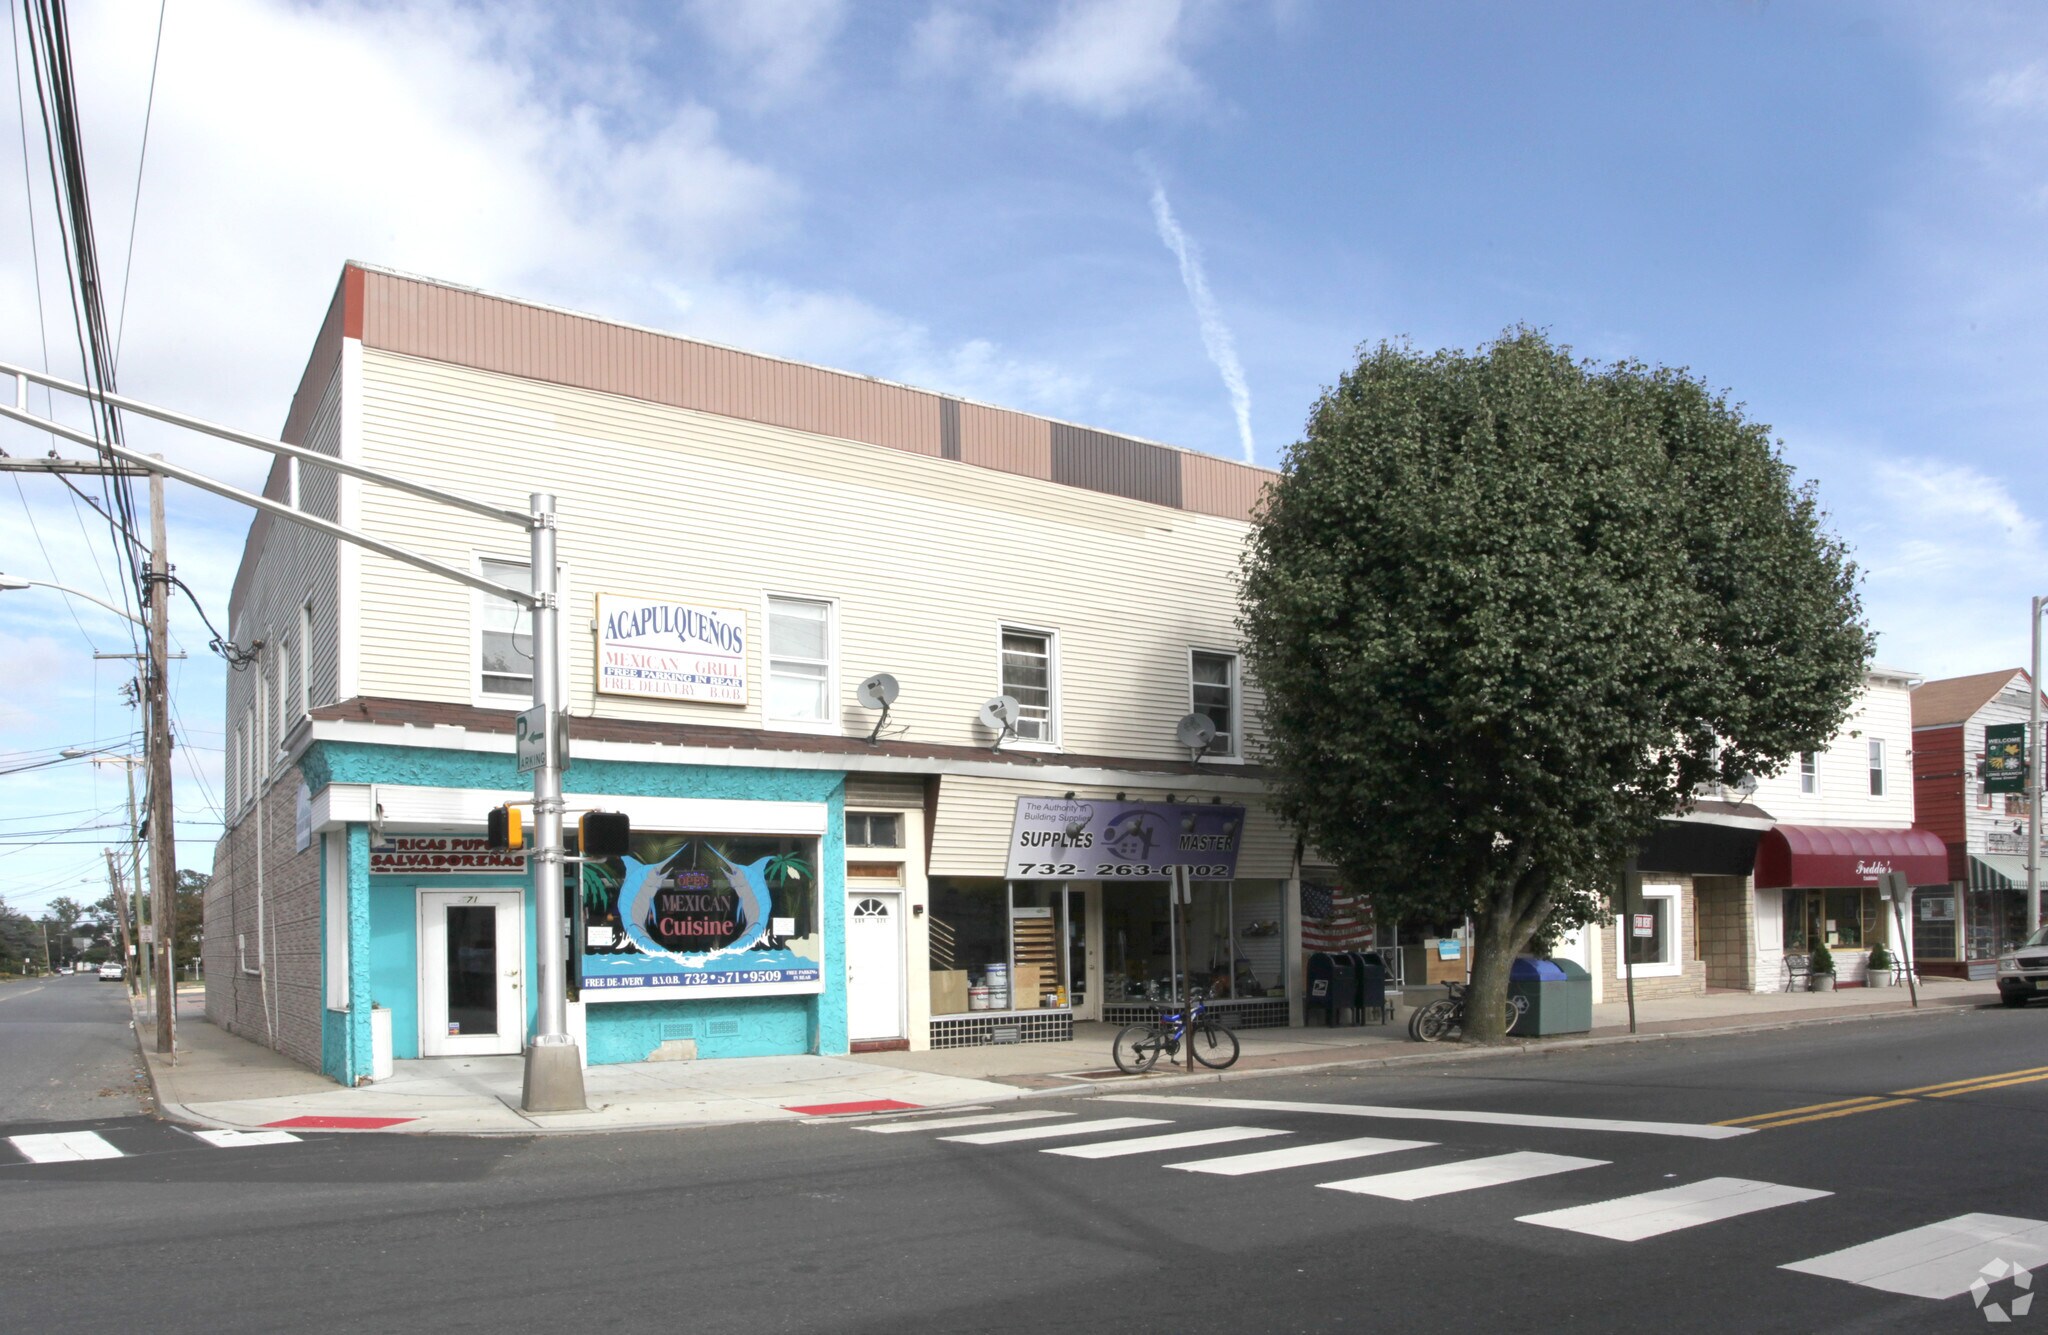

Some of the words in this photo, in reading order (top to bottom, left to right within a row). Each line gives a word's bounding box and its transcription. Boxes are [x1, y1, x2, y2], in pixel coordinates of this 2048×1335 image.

[605, 606, 743, 654] ACAPULQUEÑOS
[606, 651, 679, 671] MEXICAN
[695, 660, 741, 677] GRILL
[607, 667, 638, 677] FREE
[641, 670, 692, 683] PARKING
[695, 675, 707, 684] IN
[710, 676, 741, 687] REAR
[605, 678, 636, 691] FREE
[640, 680, 695, 696] DELIVERY
[1988, 736, 2021, 744] WELCOME
[1026, 802, 1042, 811] The
[1043, 803, 1079, 814] Authority
[1024, 812, 1057, 823] Building
[397, 838, 447, 850] RICAS
[1179, 835, 1233, 851] MASTER
[371, 851, 525, 867] SALVADOREÑAS
[1855, 860, 1893, 874] Freddie's
[677, 874, 710, 887] OPEN
[662, 895, 731, 912] MEXICAN
[660, 917, 734, 936] Cuisine
[585, 977, 605, 987] FREE
